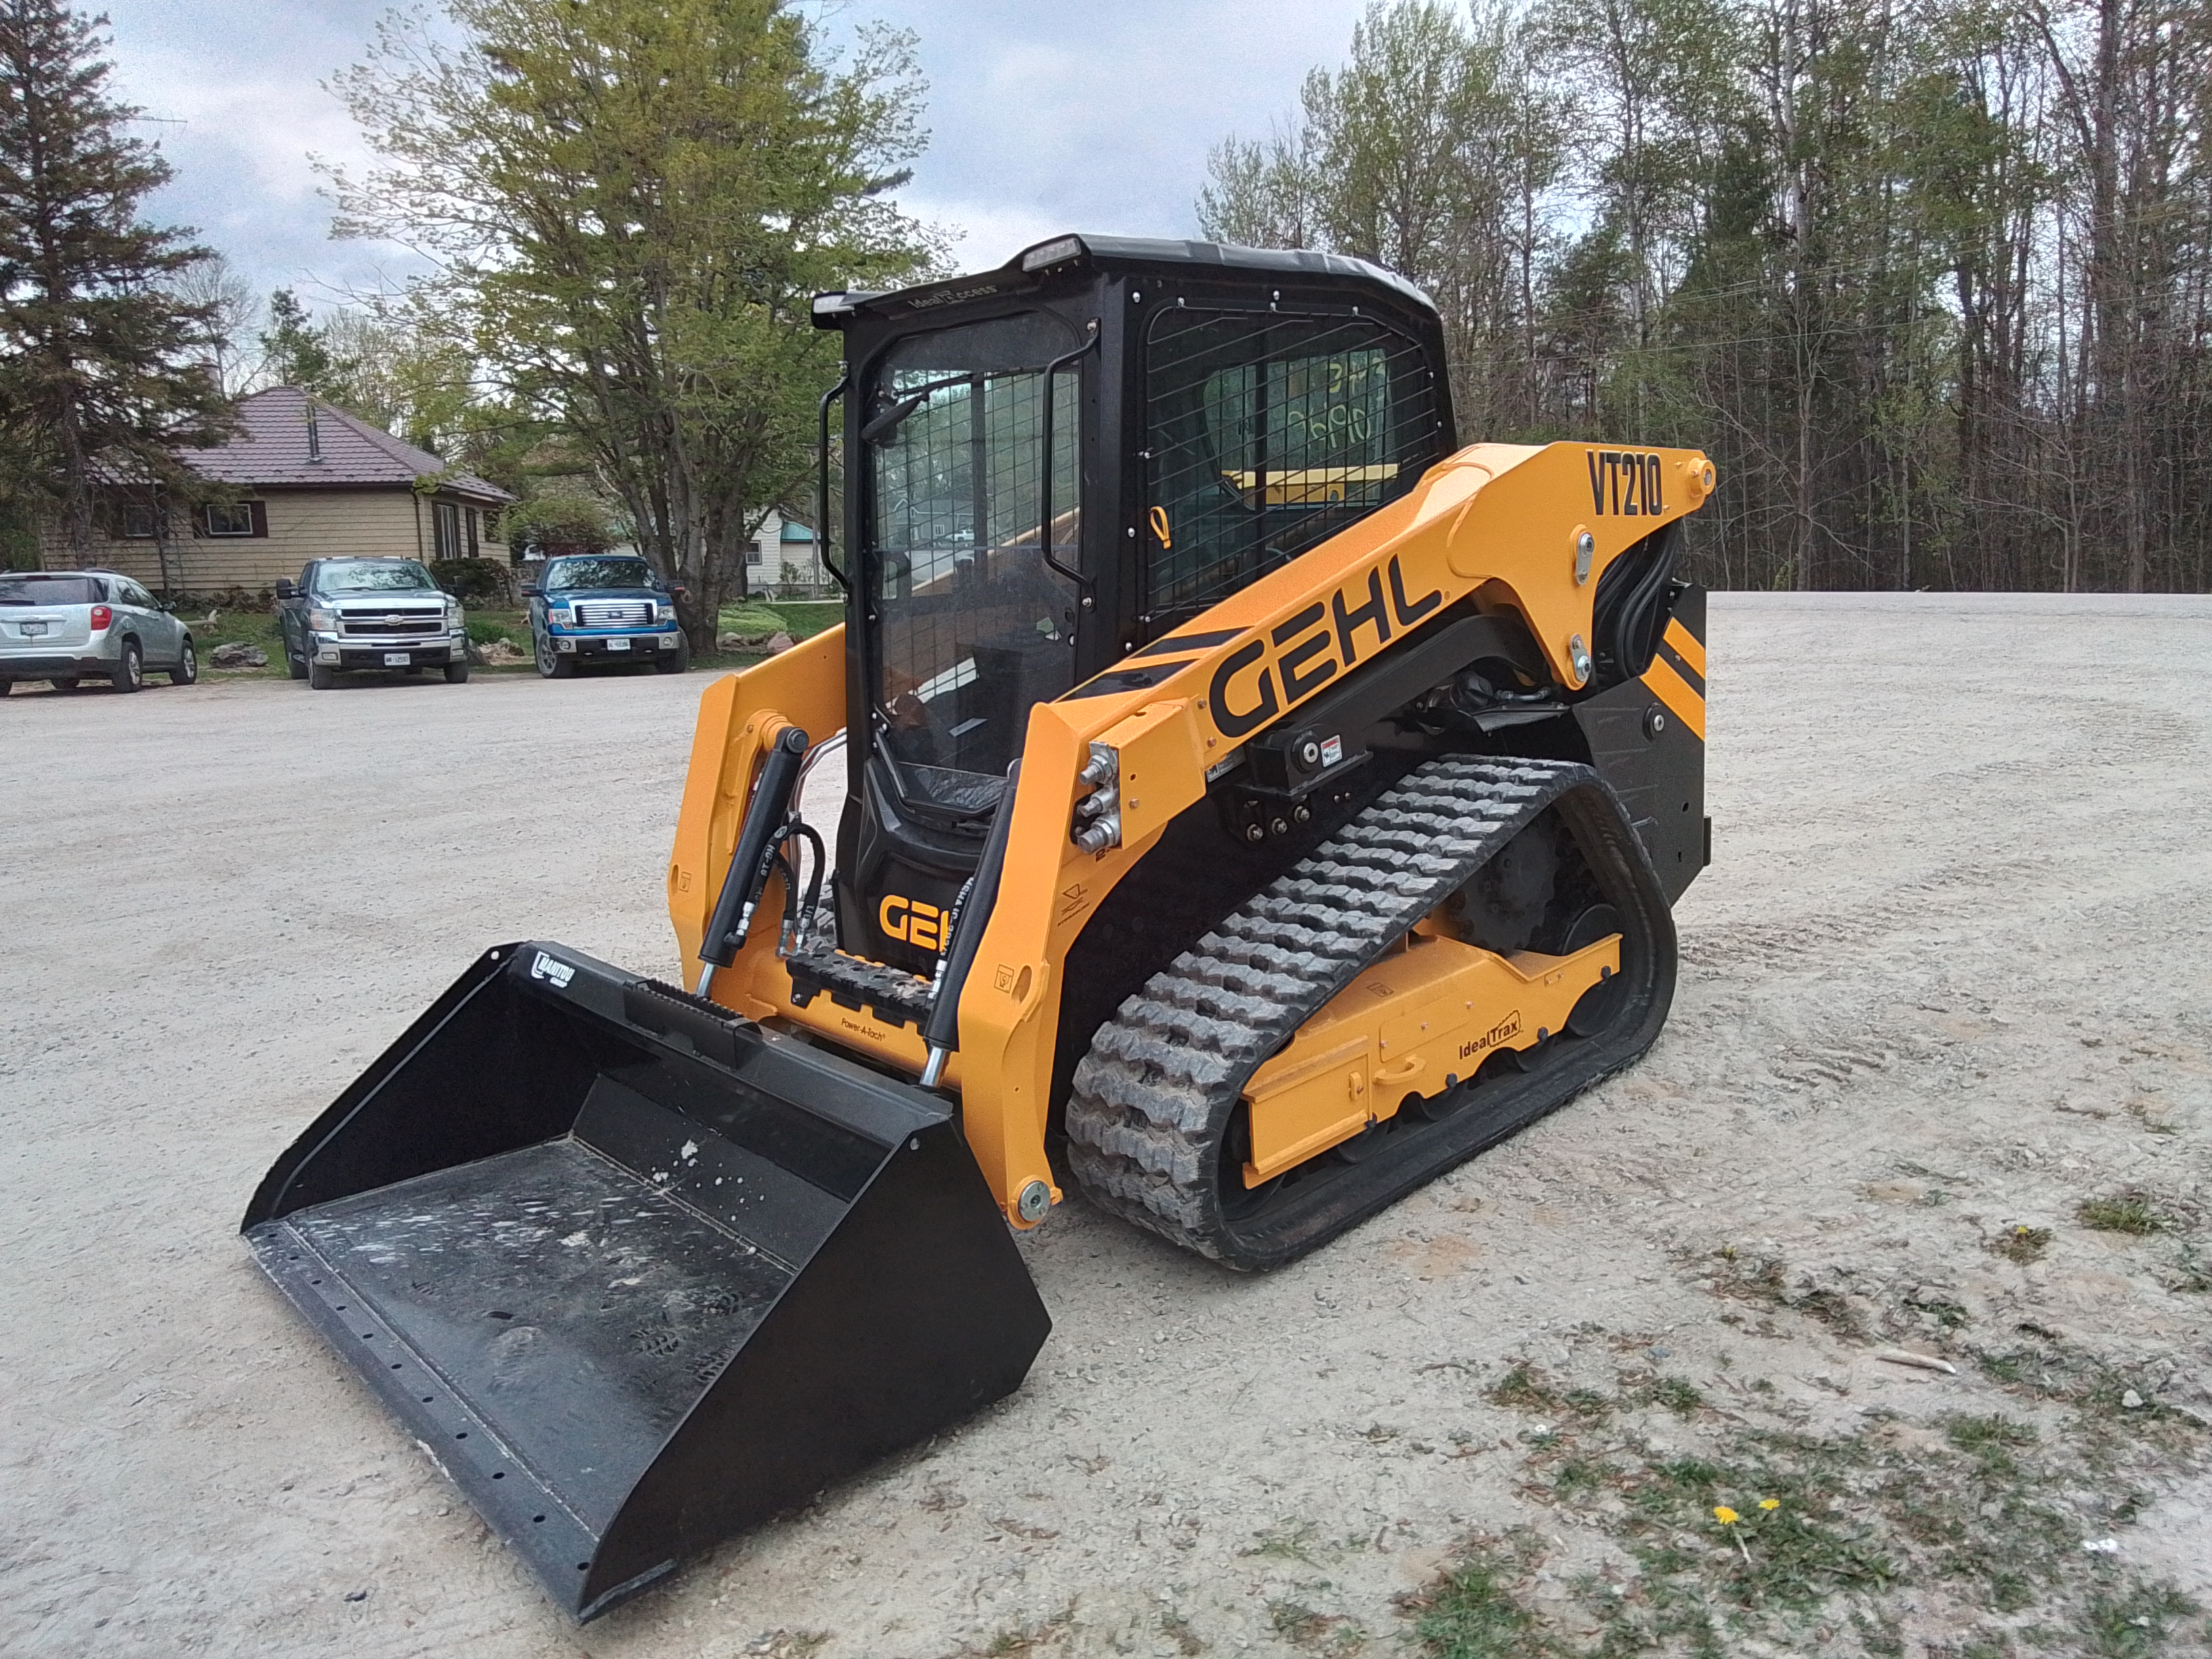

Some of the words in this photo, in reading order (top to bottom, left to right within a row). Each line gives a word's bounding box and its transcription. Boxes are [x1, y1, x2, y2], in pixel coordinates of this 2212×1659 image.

[1586, 450, 1662, 516] VT210
[1209, 552, 1442, 739] GEHL
[879, 894, 949, 953] GE
[537, 956, 576, 983] MANITOU
[1459, 1019, 1518, 1061] IdealTrax
